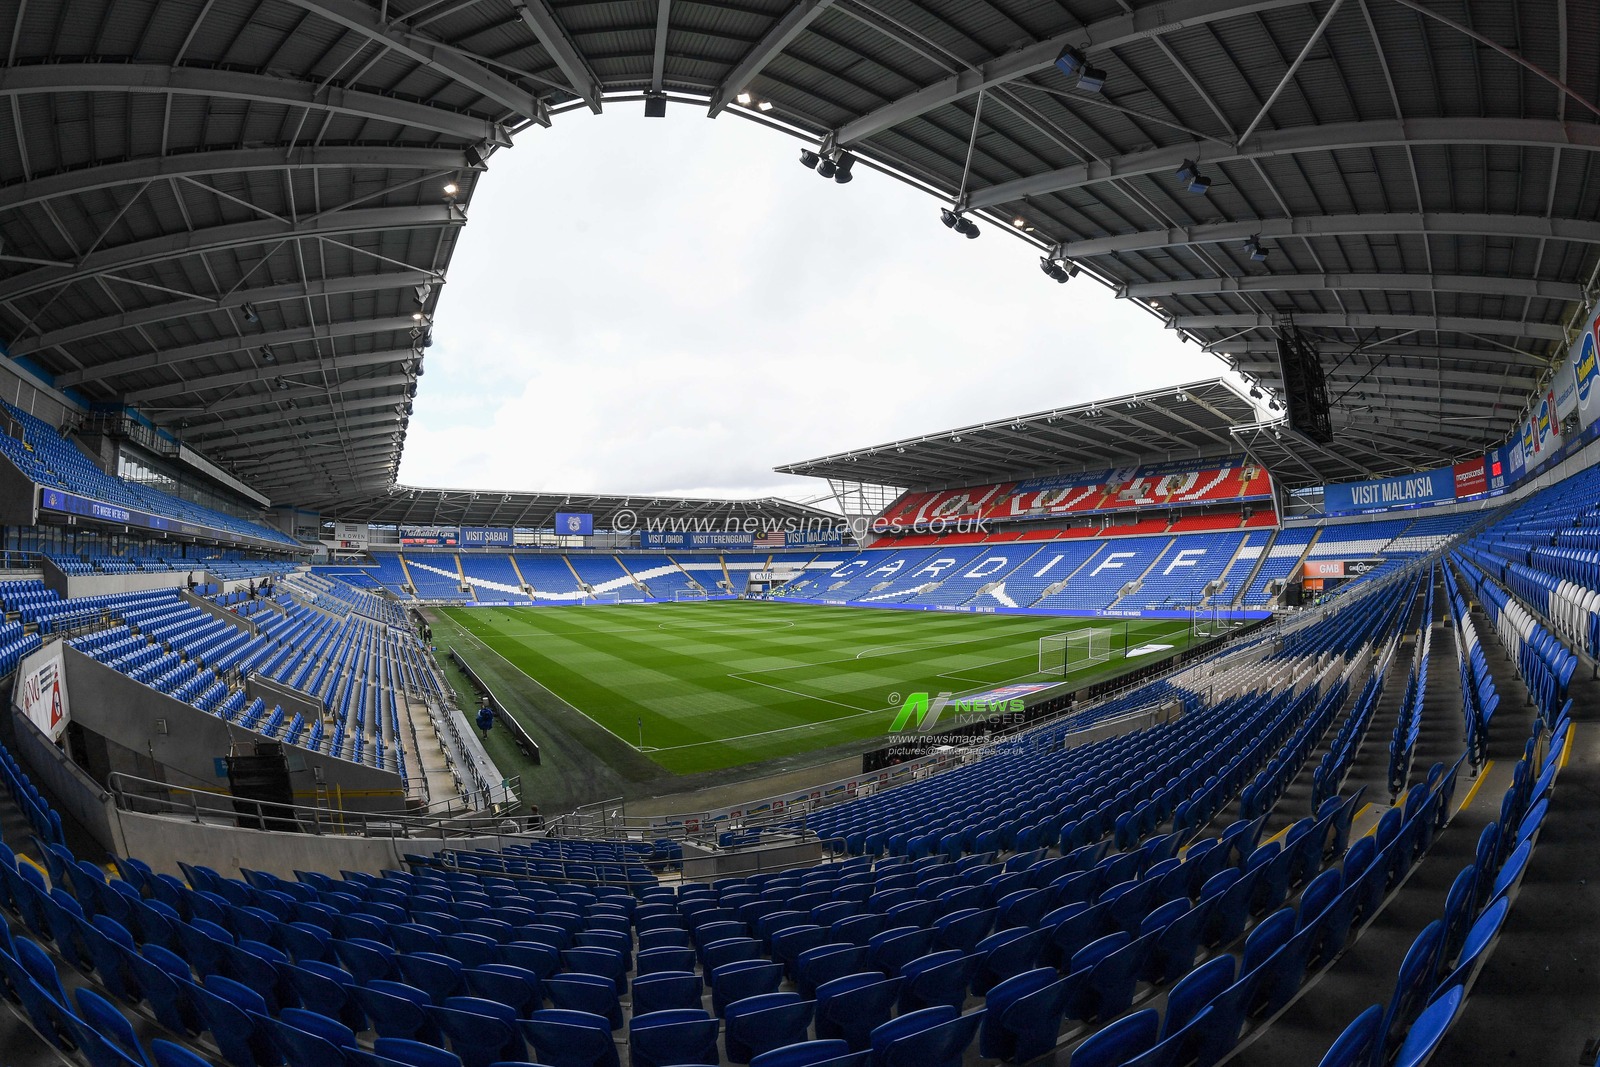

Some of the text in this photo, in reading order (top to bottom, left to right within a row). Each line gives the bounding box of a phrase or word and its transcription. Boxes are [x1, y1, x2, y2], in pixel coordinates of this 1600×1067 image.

[1352, 476, 1433, 505] VISIT MALAYSIA
[100, 506, 112, 518] WHERE
[465, 531, 508, 541] VISIT SABAH
[648, 534, 684, 543] VISIT JOHOR
[693, 534, 752, 544] VISIT TERENGGANU
[787, 530, 839, 543] VISIT MALAYSIA
[830, 548, 1206, 579] CARDIFF
[1319, 564, 1340, 574] GMB
[755, 572, 773, 580] CMB
